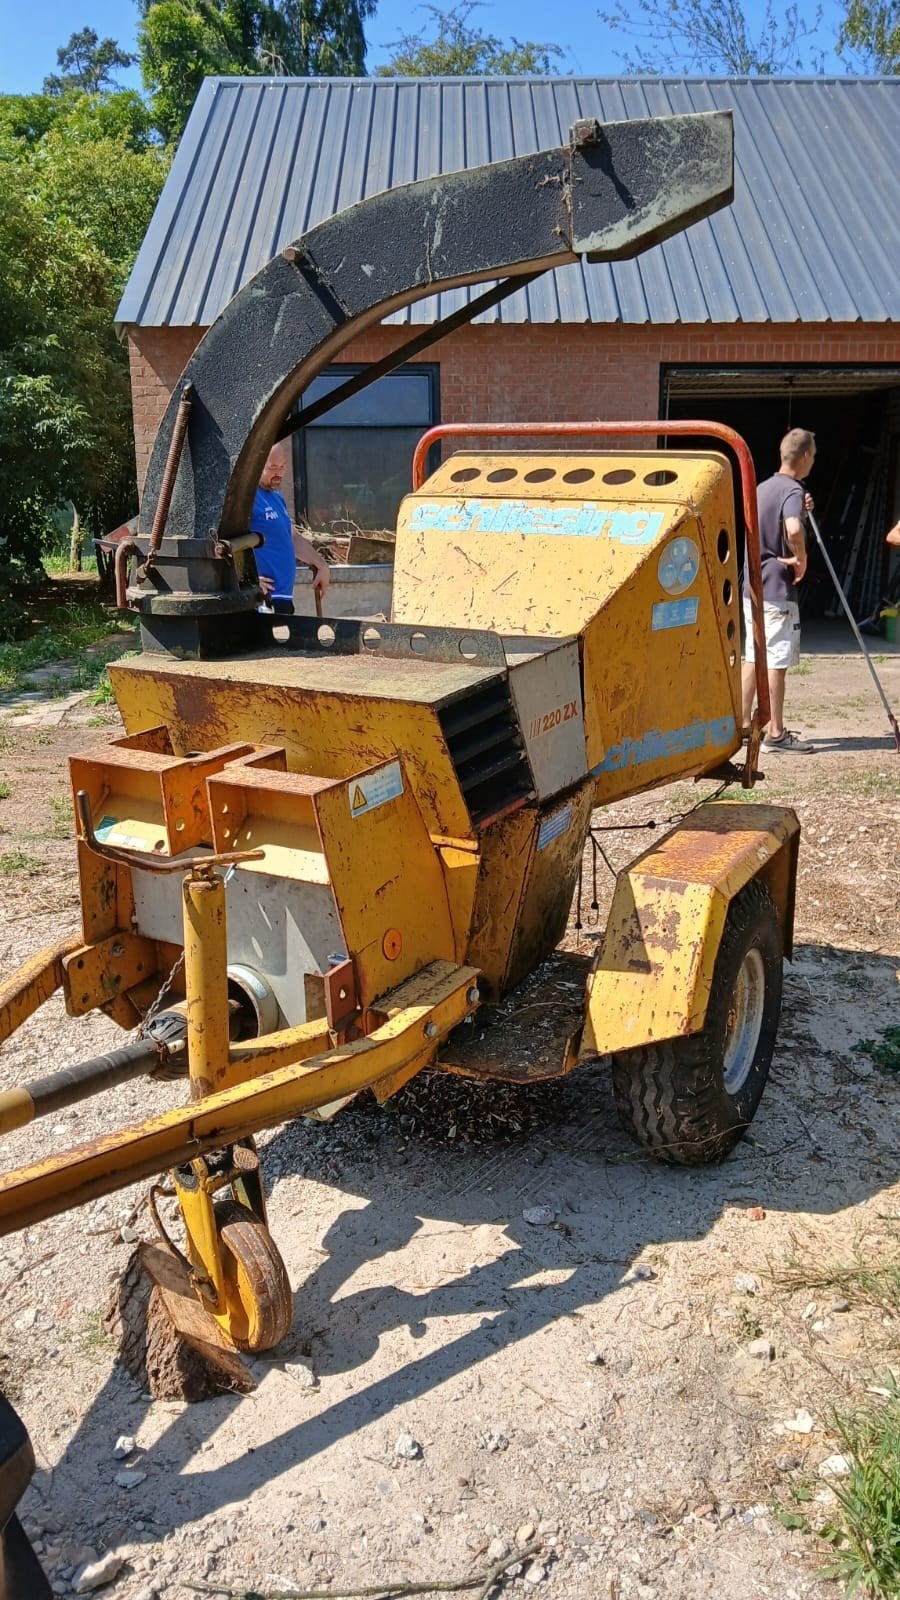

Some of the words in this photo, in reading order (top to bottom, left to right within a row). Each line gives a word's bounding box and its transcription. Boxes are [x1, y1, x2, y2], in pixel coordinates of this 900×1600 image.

[408, 500, 664, 545] schliesing
[543, 709, 561, 732] 220
[563, 700, 578, 720] ZX
